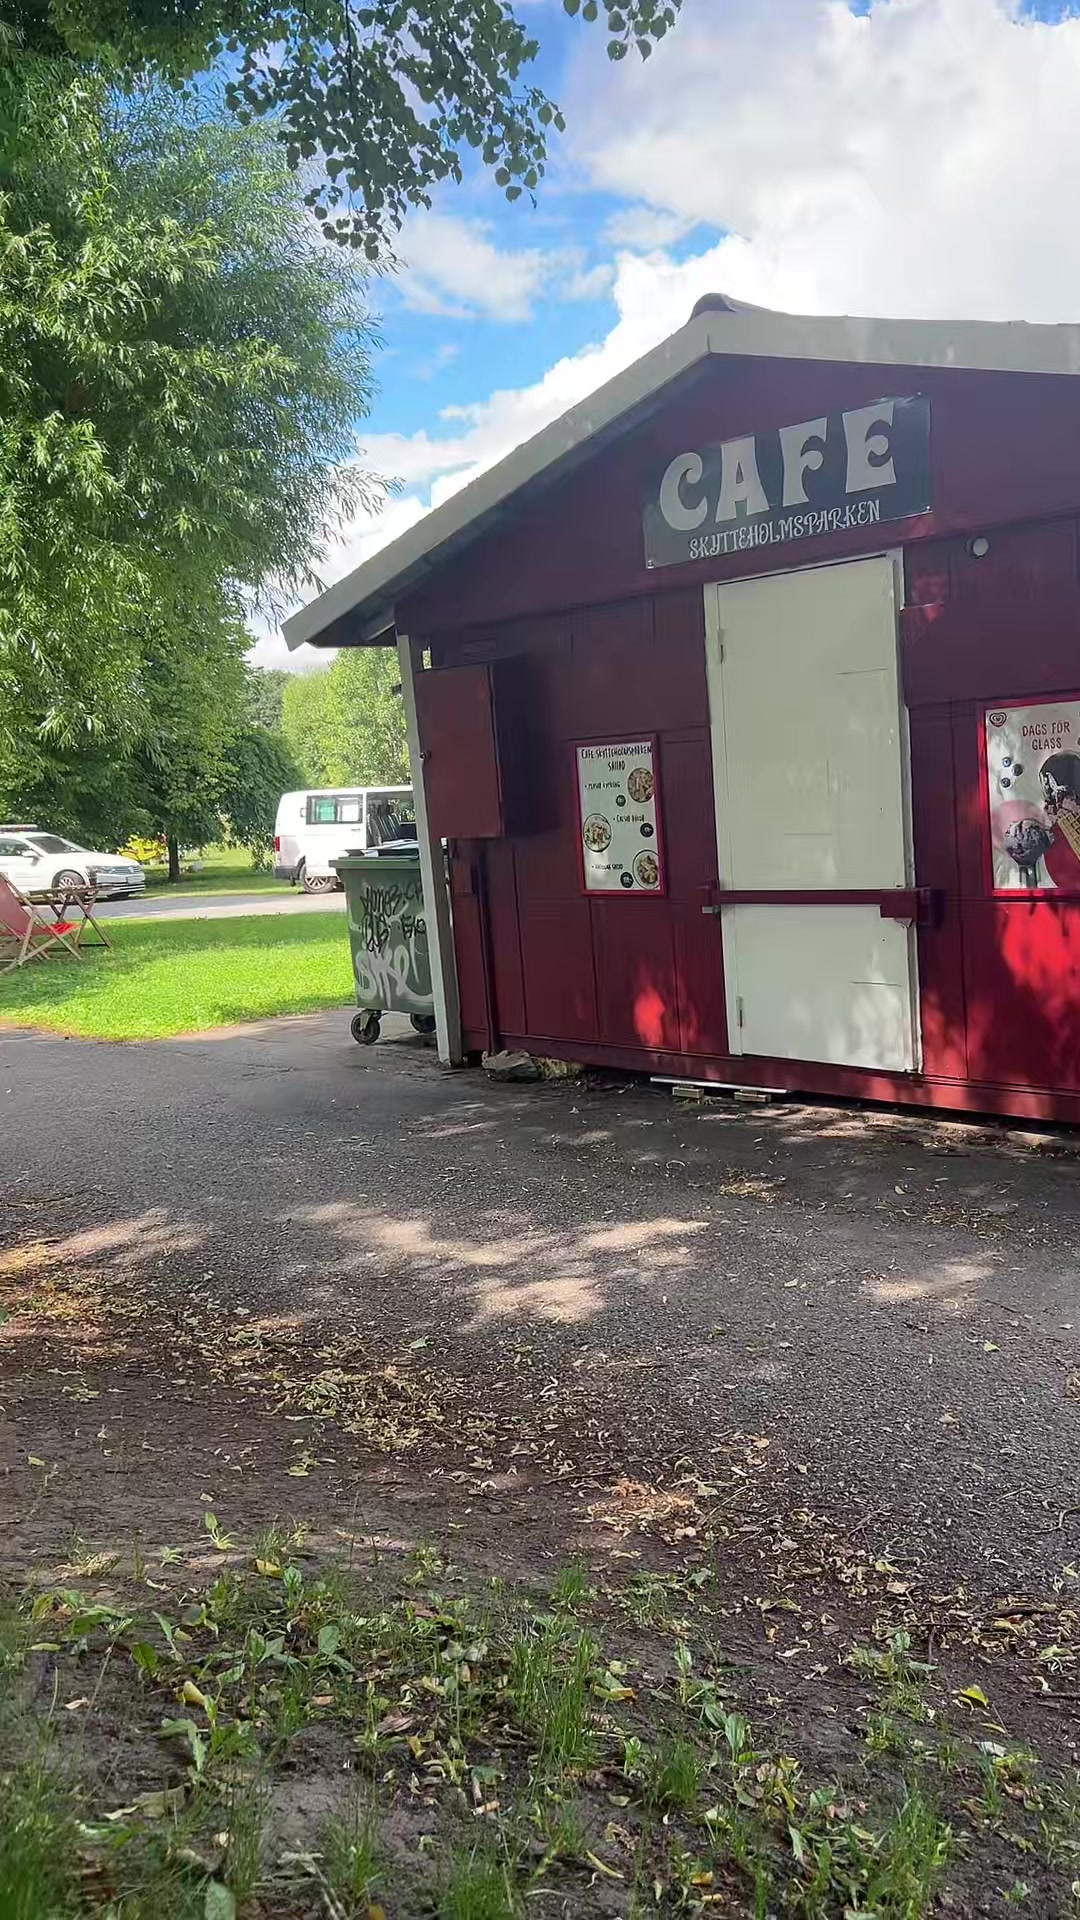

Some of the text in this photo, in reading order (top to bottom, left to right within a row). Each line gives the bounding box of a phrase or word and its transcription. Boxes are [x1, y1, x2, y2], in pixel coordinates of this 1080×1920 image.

[659, 401, 896, 531] CAFE
[689, 499, 880, 559] SKYTTEHOLMSPARKEN
[1022, 723, 1047, 737] DAGS
[1031, 737, 1062, 751] GLASS
